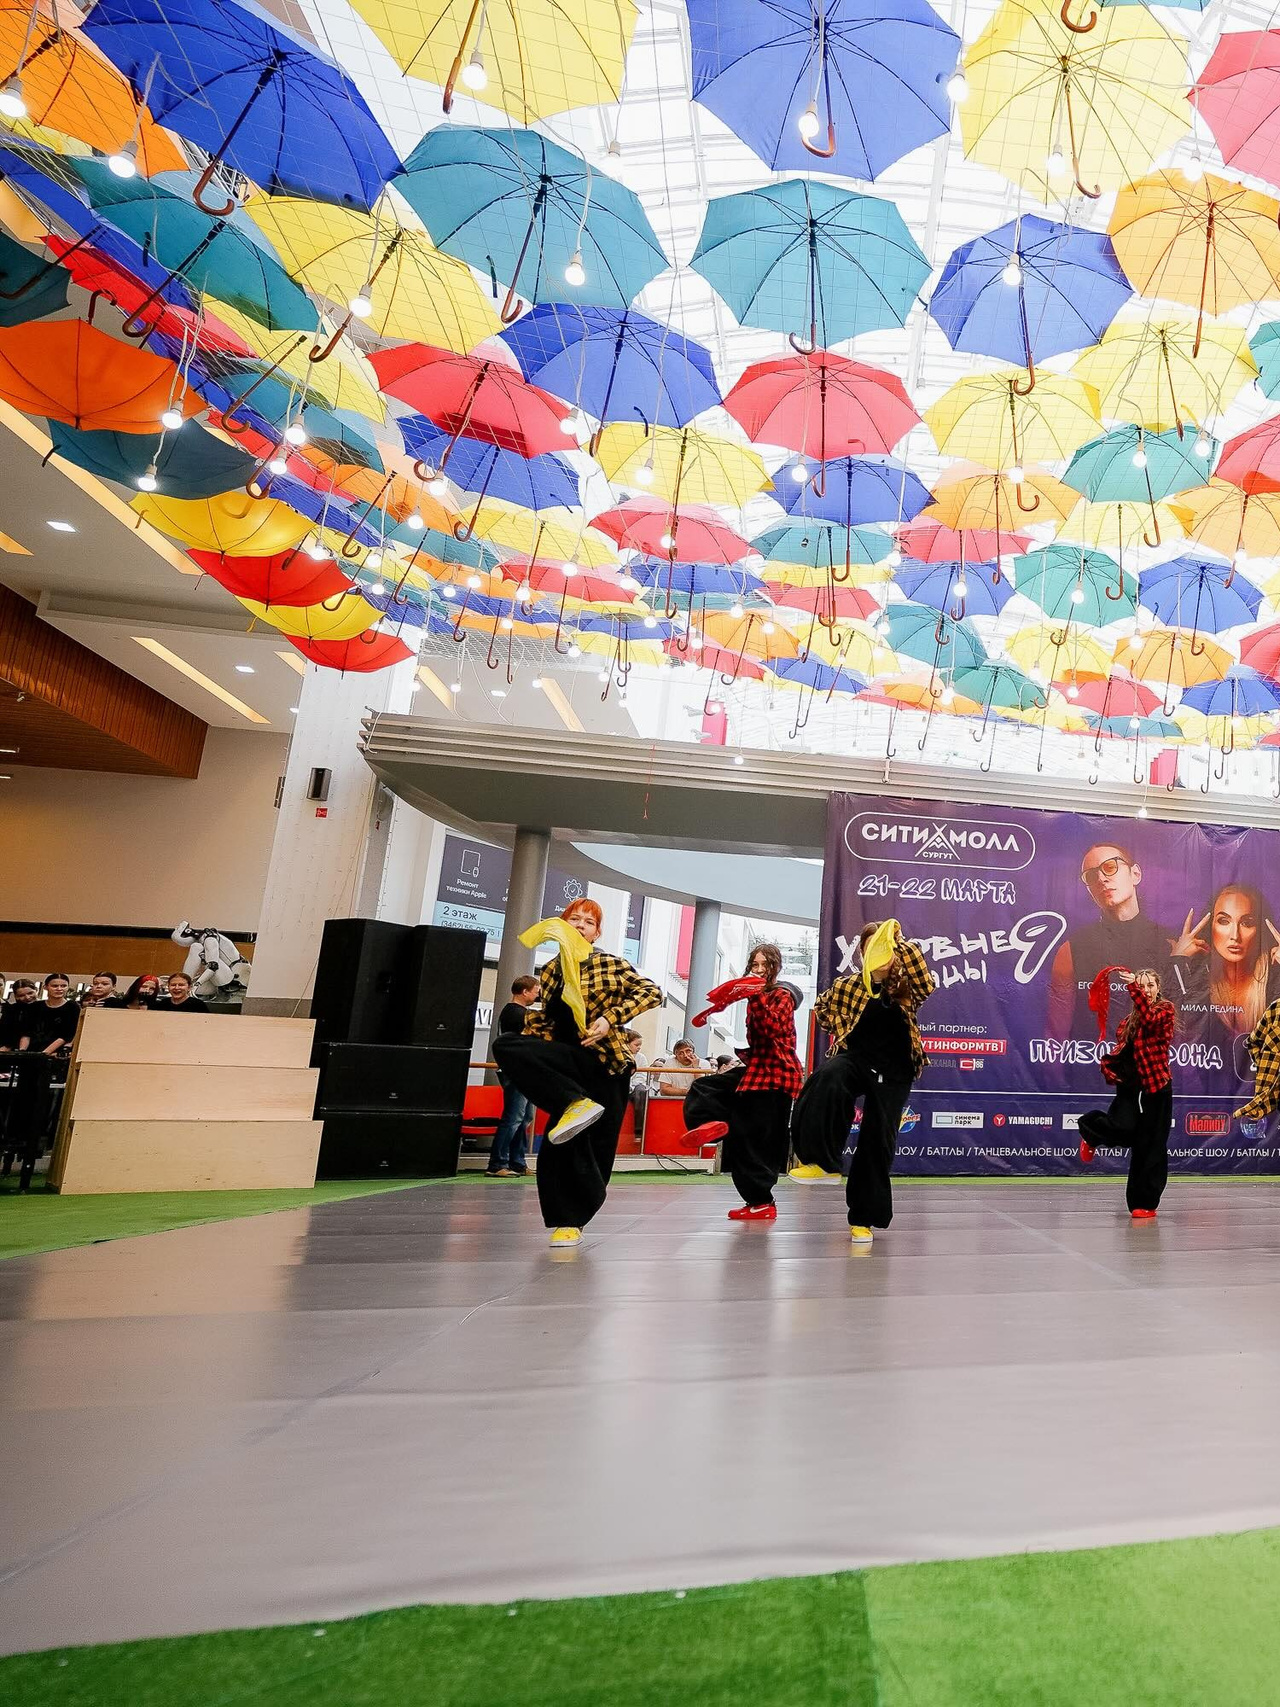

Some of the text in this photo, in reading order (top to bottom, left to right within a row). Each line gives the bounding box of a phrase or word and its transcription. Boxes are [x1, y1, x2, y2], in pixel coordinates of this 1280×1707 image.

[922, 851, 953, 860] СУРГУТ
[456, 878, 479, 888] Ремонт
[446, 885, 487, 899] техники Apple
[857, 874, 1016, 905] 21-22 МАРТА
[443, 906, 478, 920] 2 этаж
[1180, 1004, 1244, 1013] МИЛА РЕДИНА
[939, 1024, 987, 1034] партнер:
[1008, 1116, 1053, 1125] YAMAGUCHI
[927, 1147, 964, 1156] БАТТЛЫ
[974, 1147, 1052, 1157] ТАНЦЕВАЛЬНОЕ
[1053, 1148, 1079, 1157] ШОУ
[1094, 1148, 1123, 1156] АТТЛЫ
[1205, 1148, 1229, 1157] ШОУ
[1236, 1148, 1270, 1157] БАТТЛЫ
